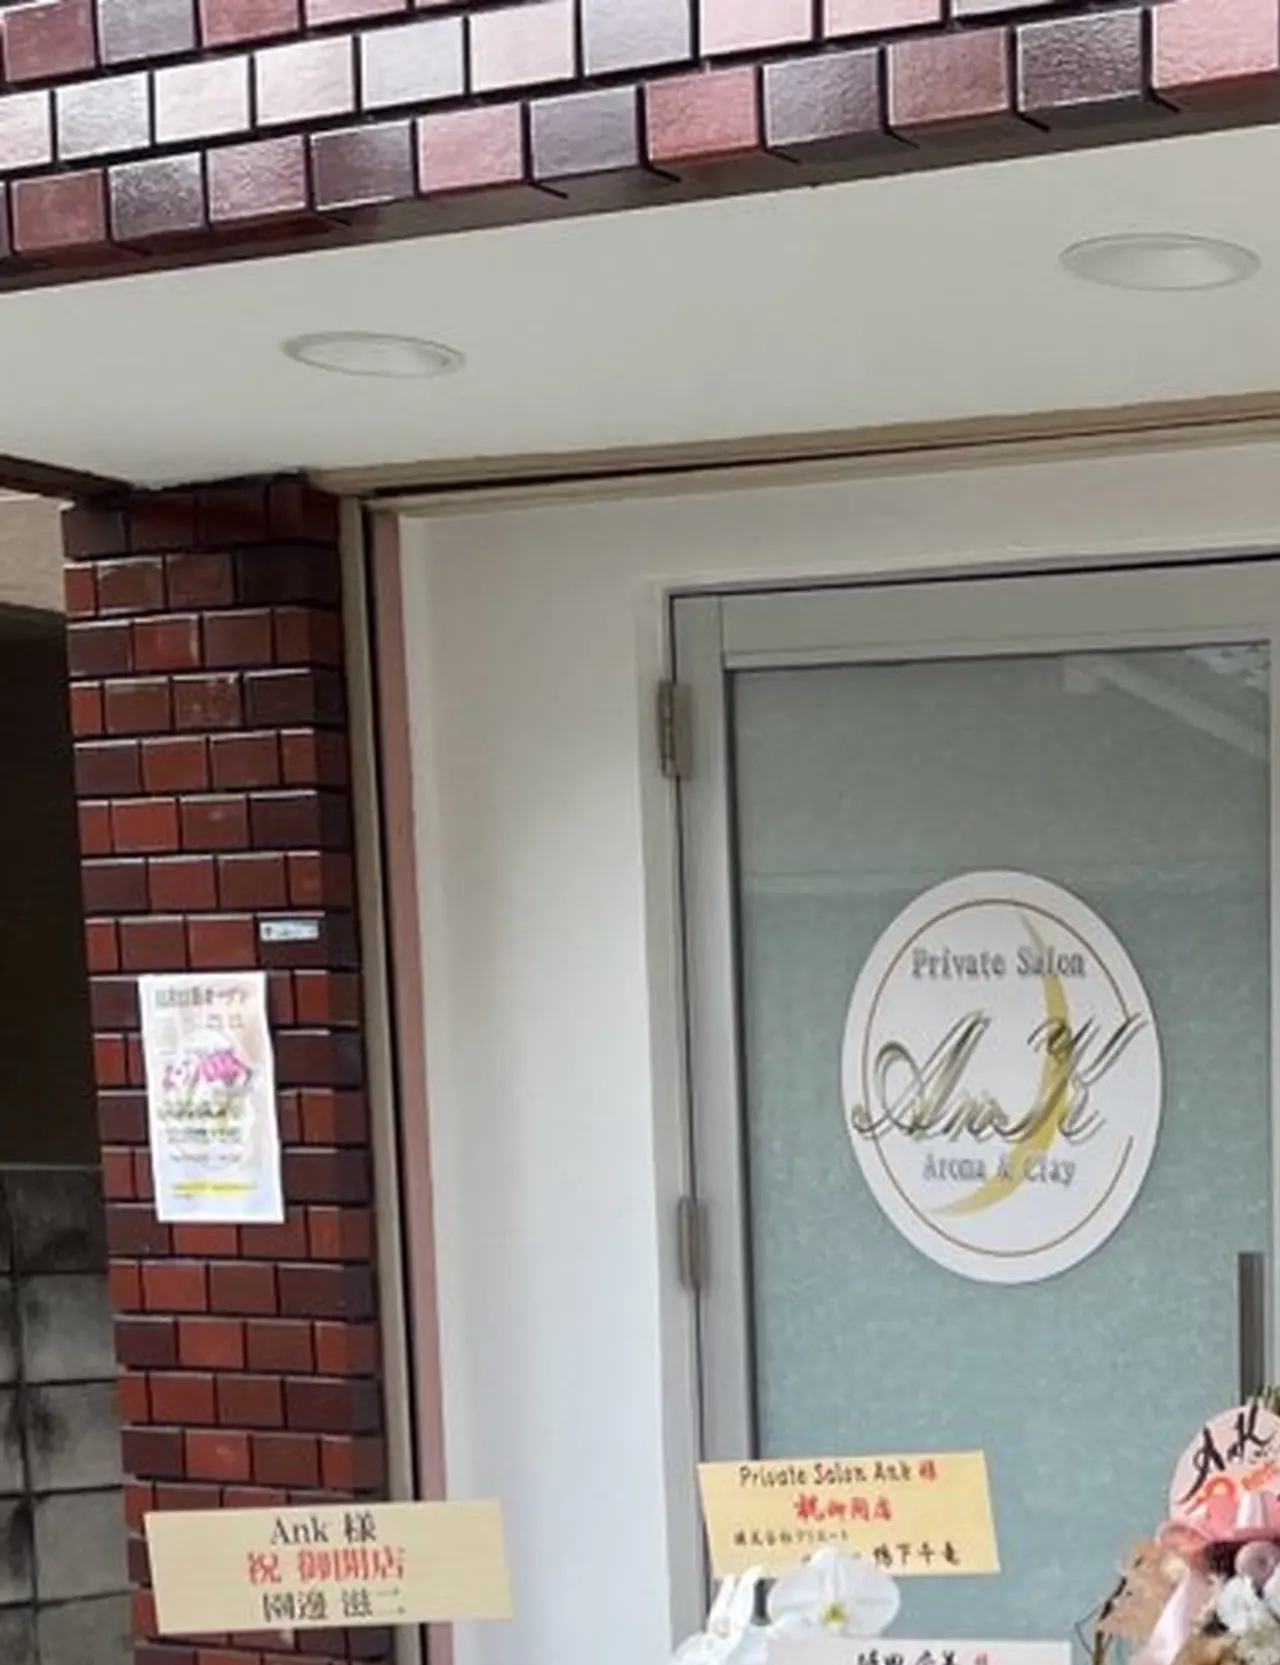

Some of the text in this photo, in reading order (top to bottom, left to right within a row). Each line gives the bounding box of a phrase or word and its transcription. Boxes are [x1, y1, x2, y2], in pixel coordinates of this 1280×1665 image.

[911, 946, 1087, 978] Private Salon
[923, 1154, 988, 1182] Aroma
[1021, 1156, 1076, 1187] Clay
[270, 1510, 377, 1546] Ank 様
[249, 1547, 405, 1584] 祝 御開店
